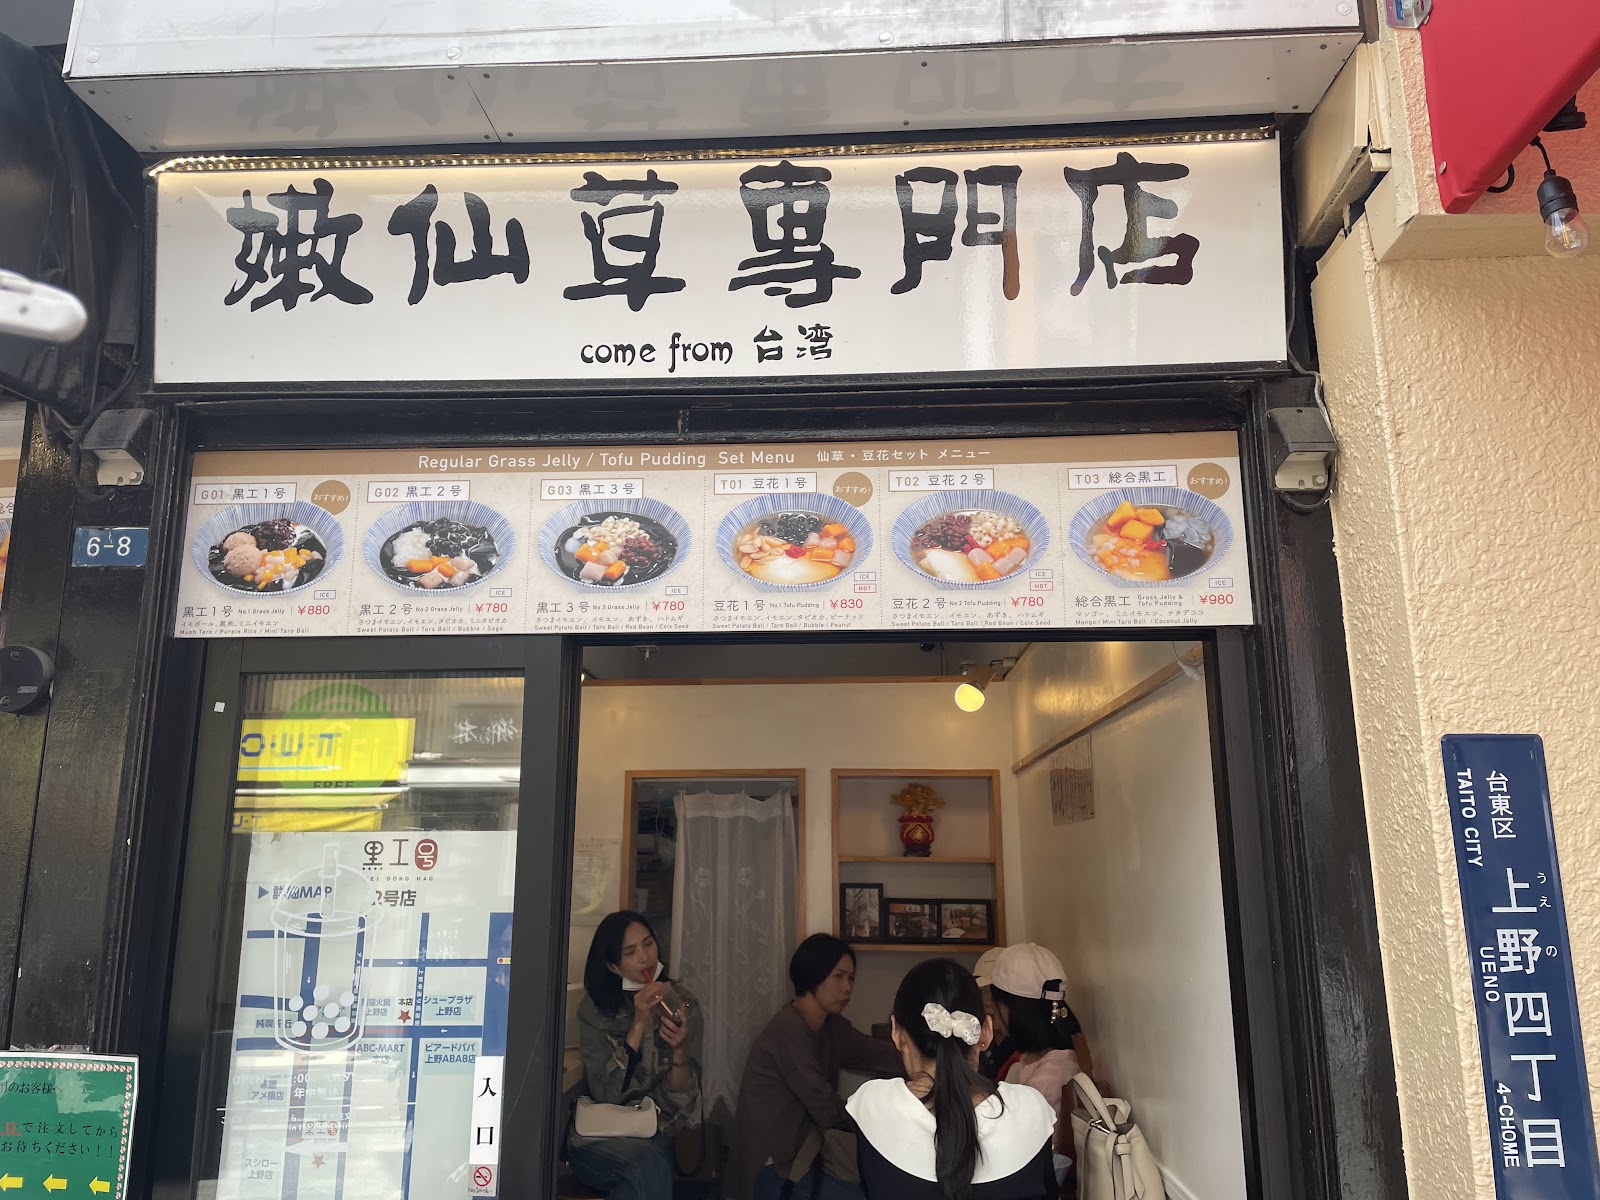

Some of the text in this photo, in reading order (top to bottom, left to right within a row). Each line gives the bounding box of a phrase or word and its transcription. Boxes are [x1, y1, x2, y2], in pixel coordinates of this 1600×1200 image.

[580, 323, 833, 373] come from 台湾
[418, 455, 482, 470] Regular
[488, 455, 536, 469] Grass
[542, 453, 581, 470] Jelly
[600, 452, 633, 466] Tofu
[640, 451, 706, 468] Pudding
[718, 451, 745, 465] Set
[751, 451, 795, 464] Menu
[938, 448, 990, 459] メニュー
[896, 476, 919, 486] T02
[1075, 471, 1166, 484] T03 総合黒工
[720, 479, 743, 489] T01
[201, 489, 224, 499] G01
[374, 487, 399, 497] G02
[548, 485, 572, 495] G03
[86, 536, 131, 557] 6-8
[652, 601, 684, 611] ¥780
[830, 599, 863, 609] ¥830
[1011, 596, 1044, 607] ¥780
[1075, 595, 1131, 608] 総合黒工
[1200, 594, 1234, 605] ¥980
[298, 605, 330, 615] ¥880
[475, 603, 507, 613] ¥780
[1486, 770, 1518, 839] 台東区
[1457, 768, 1484, 867] TAITO CITY
[1480, 946, 1500, 1002] UENO
[398, 997, 414, 1006] 本店
[435, 1007, 462, 1016] 上野店
[1492, 867, 1566, 1168] 上野四丁目
[356, 1043, 405, 1053] ABC-MART
[476, 1077, 497, 1146] 入口
[1496, 1083, 1520, 1168] 4-CHOME
